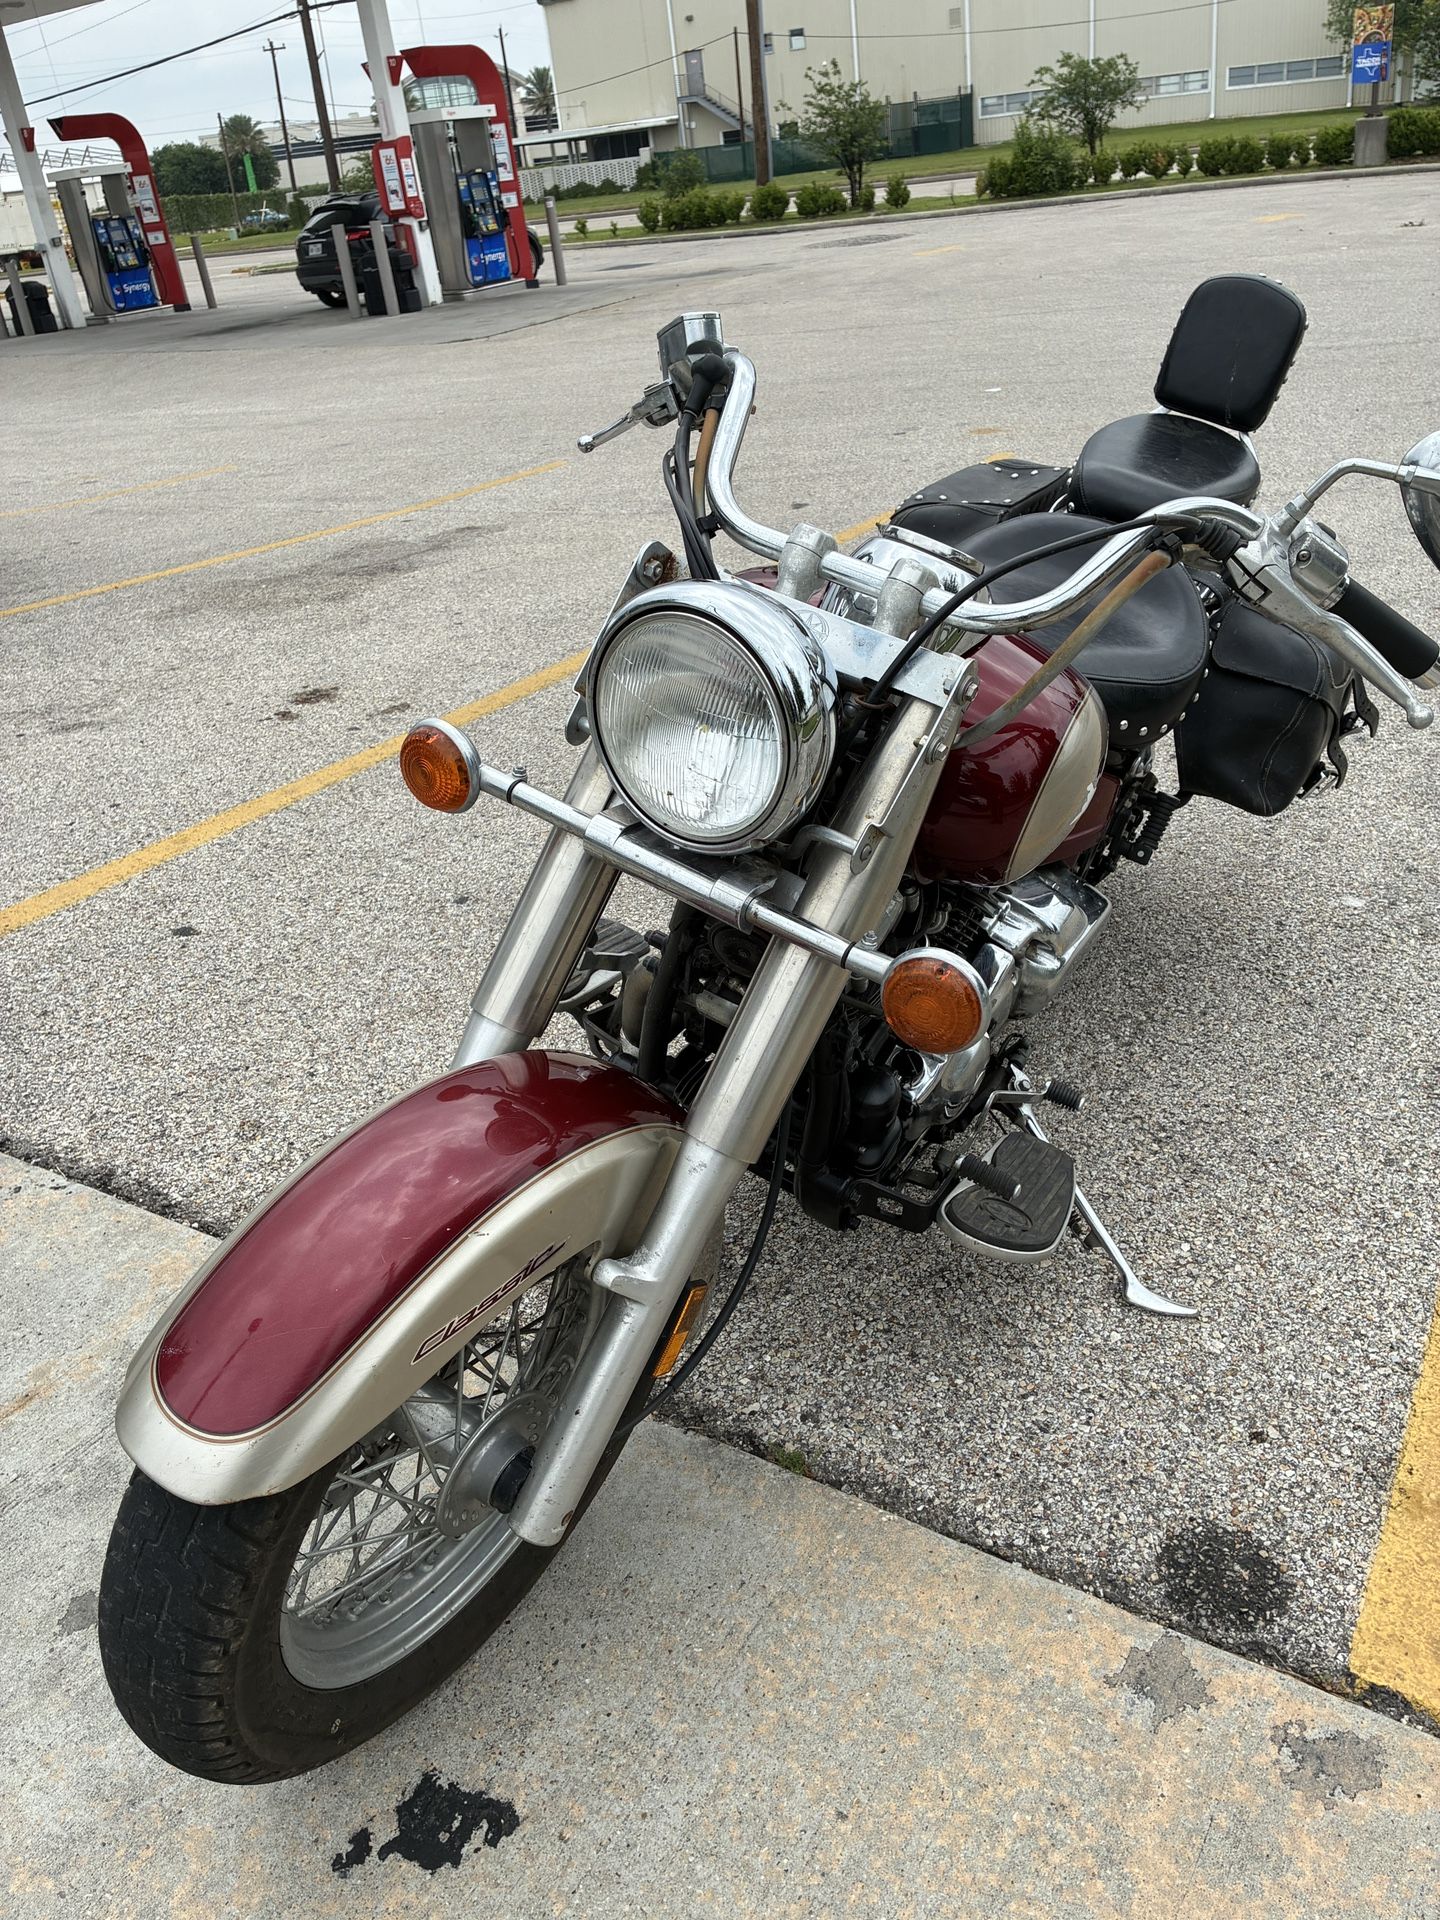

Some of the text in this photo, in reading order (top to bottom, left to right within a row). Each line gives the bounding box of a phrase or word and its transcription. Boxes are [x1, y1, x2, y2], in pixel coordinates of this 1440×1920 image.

[480, 251, 506, 264] Synergy
[122, 282, 151, 294] Synergy
[410, 1236, 570, 1365] Classic
